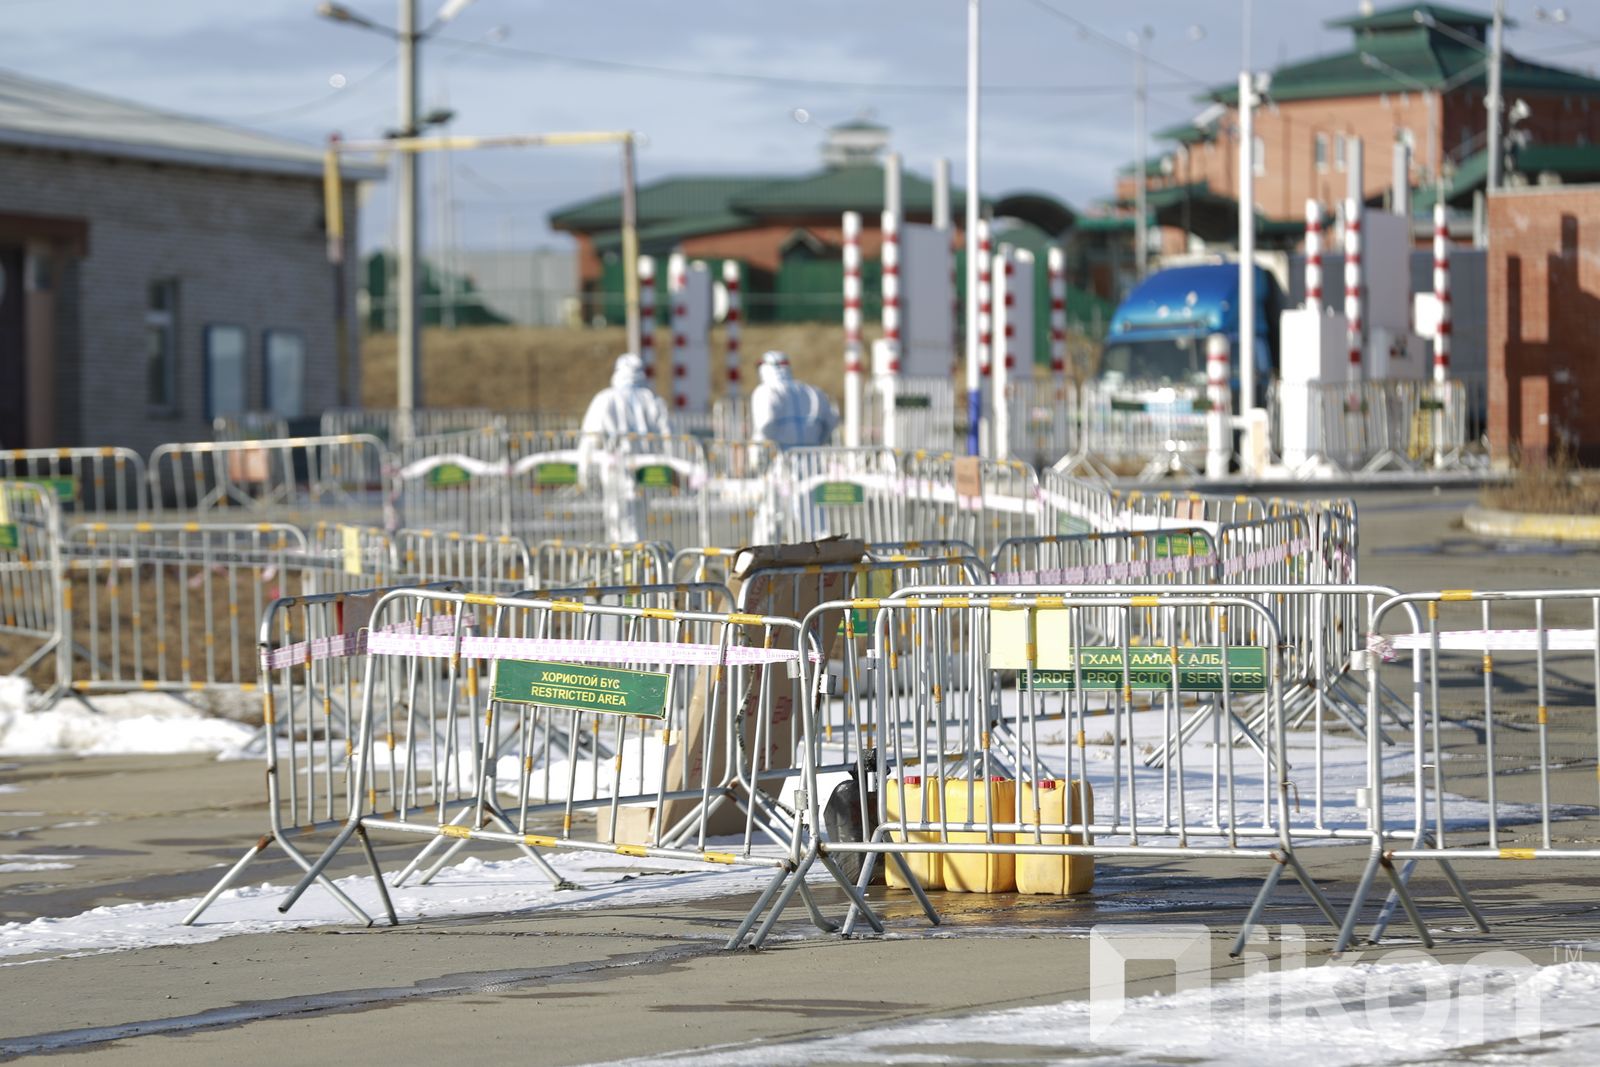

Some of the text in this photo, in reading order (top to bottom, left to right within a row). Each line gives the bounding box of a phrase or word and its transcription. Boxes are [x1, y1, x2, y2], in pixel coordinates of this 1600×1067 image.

[1088, 653, 1185, 665] ХАМААЛАХ
[541, 671, 598, 687] ХОРИОТОЙ
[1021, 672, 1080, 684] BORDE
[1187, 671, 1262, 684] SERVCES
[531, 686, 627, 706] RESTRICTED AREA
